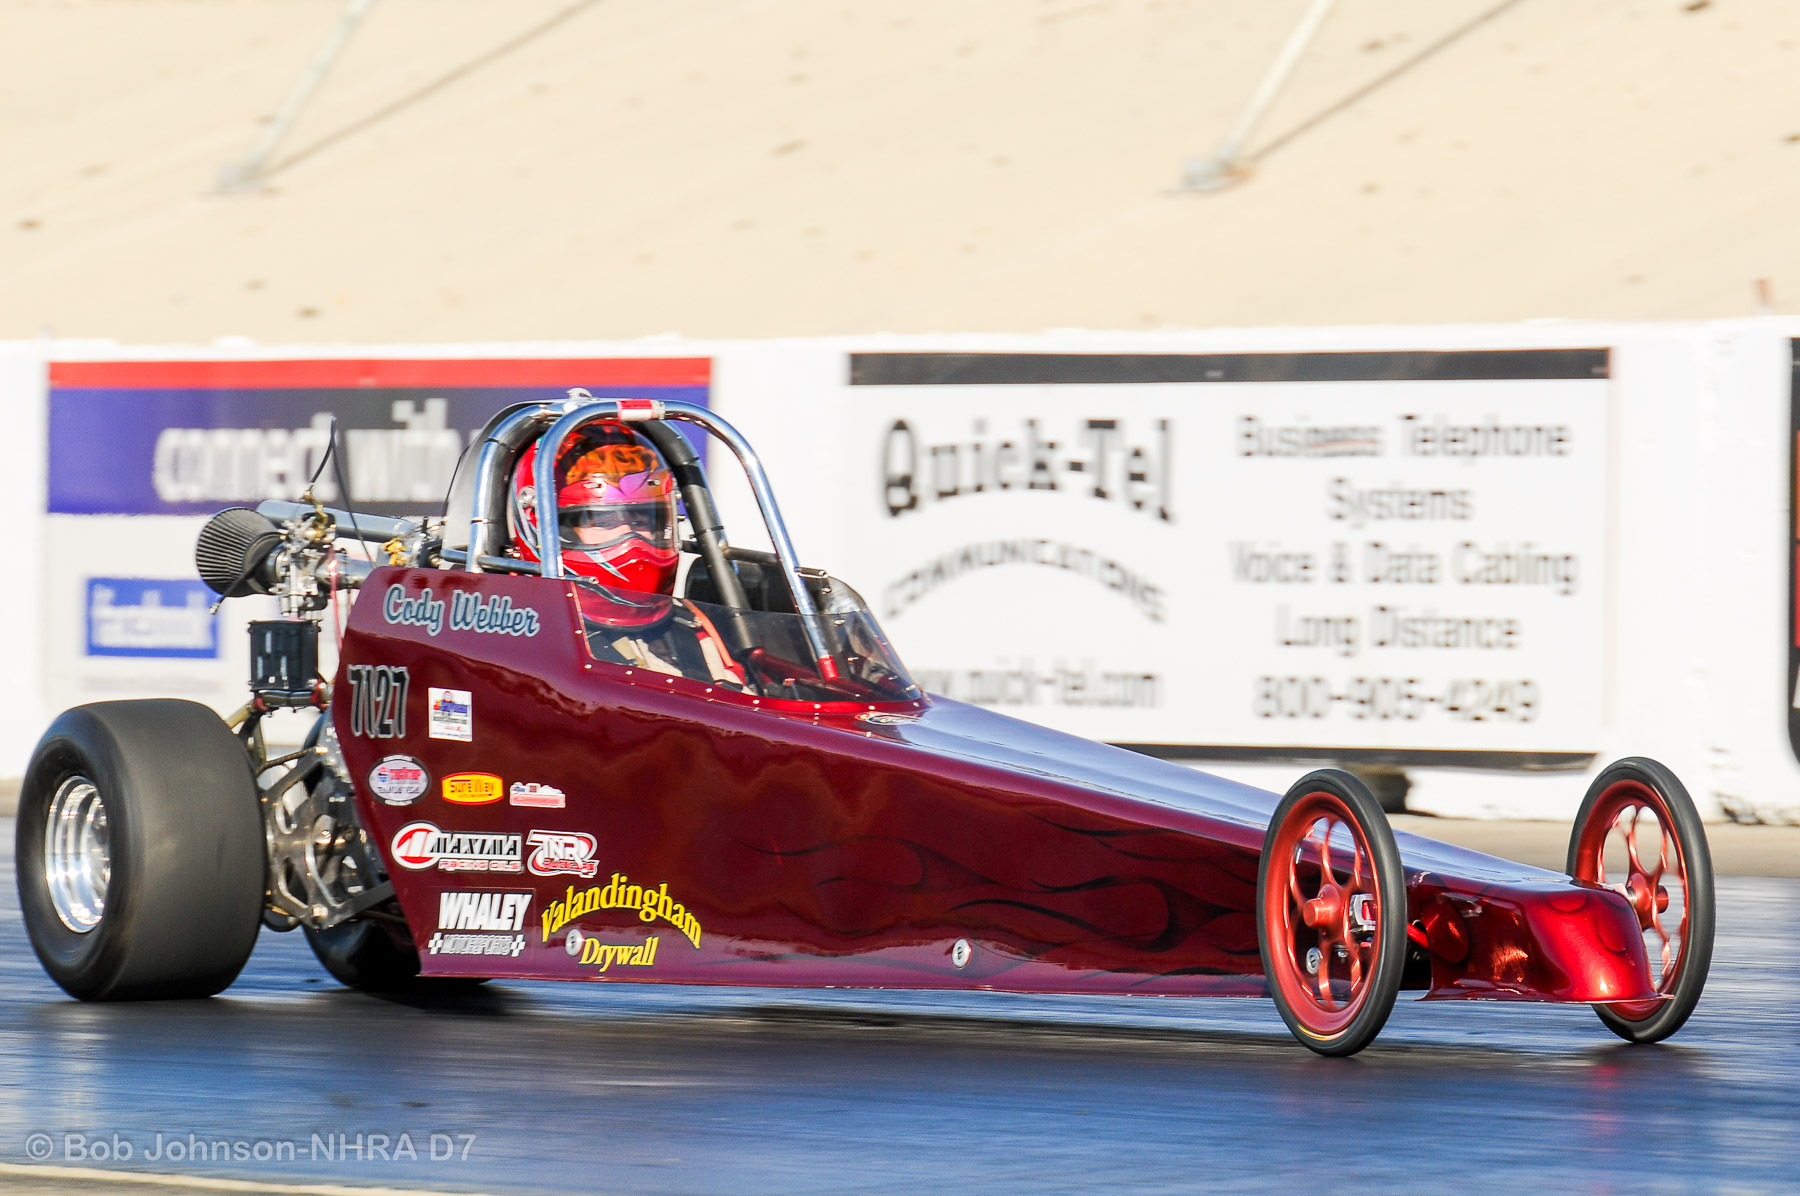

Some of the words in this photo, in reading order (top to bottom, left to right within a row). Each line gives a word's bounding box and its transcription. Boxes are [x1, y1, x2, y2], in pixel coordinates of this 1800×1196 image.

[346, 397, 461, 502] with
[1238, 413, 1383, 458] Business
[1398, 413, 1572, 465] Telephone
[877, 417, 1176, 525] Quick-Tel
[1327, 476, 1474, 530] Systems
[884, 538, 1166, 623] COMMUNICATIONS
[1230, 541, 1316, 585] Voice
[1328, 541, 1353, 585] &
[1364, 540, 1441, 585] Data
[1453, 540, 1579, 597] Cabling
[383, 584, 445, 636] Cody
[450, 589, 541, 637] Webber
[1275, 604, 1359, 659] Long
[1369, 604, 1522, 650] Distance
[347, 664, 410, 739] 7127
[1254, 675, 1540, 724] 800-905-4249
[489, 860, 521, 873] OILS
[438, 892, 533, 931] WHALEY
[541, 872, 702, 949] Valandingham
[578, 936, 659, 973] Drywall
